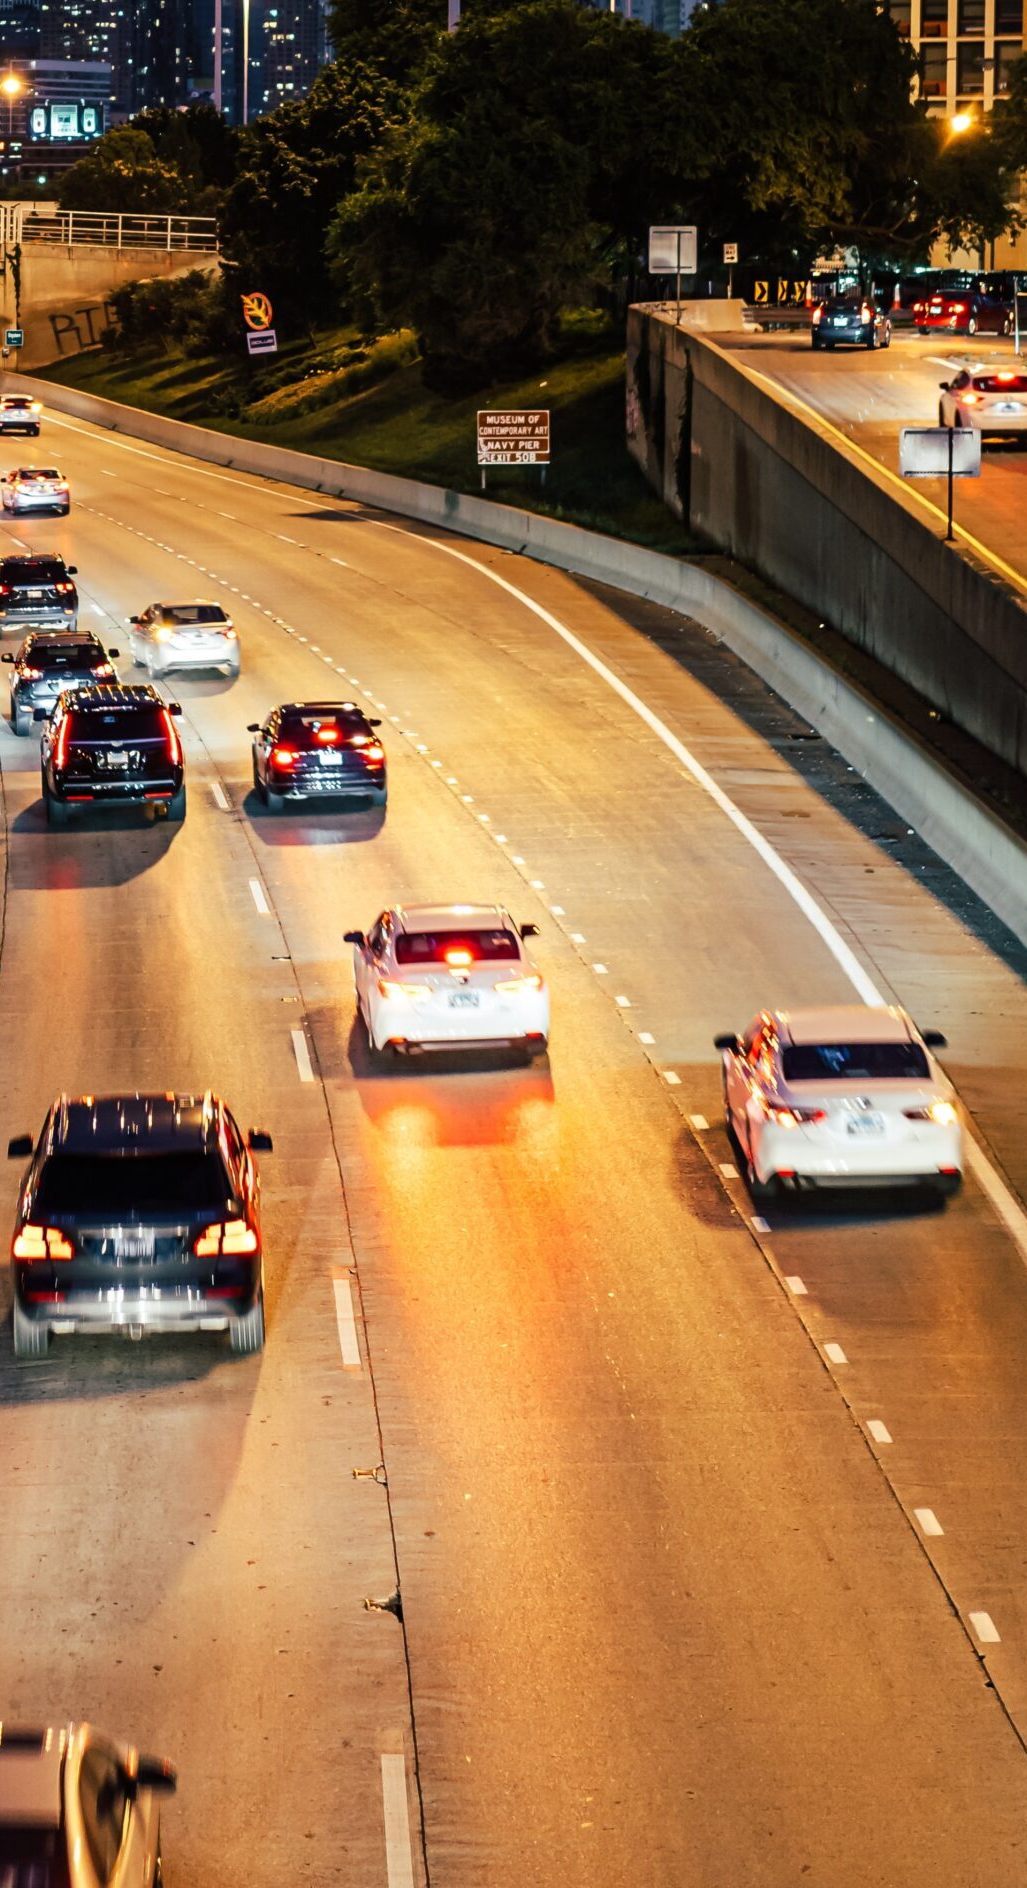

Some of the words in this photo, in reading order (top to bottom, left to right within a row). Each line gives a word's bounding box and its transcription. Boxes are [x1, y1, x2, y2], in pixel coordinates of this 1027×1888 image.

[486, 415, 525, 424] MUSEUM
[528, 415, 540, 424] OF
[479, 426, 532, 435] CONTEMPORARY
[534, 426, 548, 434] ART
[487, 441, 515, 450] NAVY
[518, 440, 540, 450] PIER
[490, 453, 511, 462] EXIT
[515, 452, 537, 462] 50B
